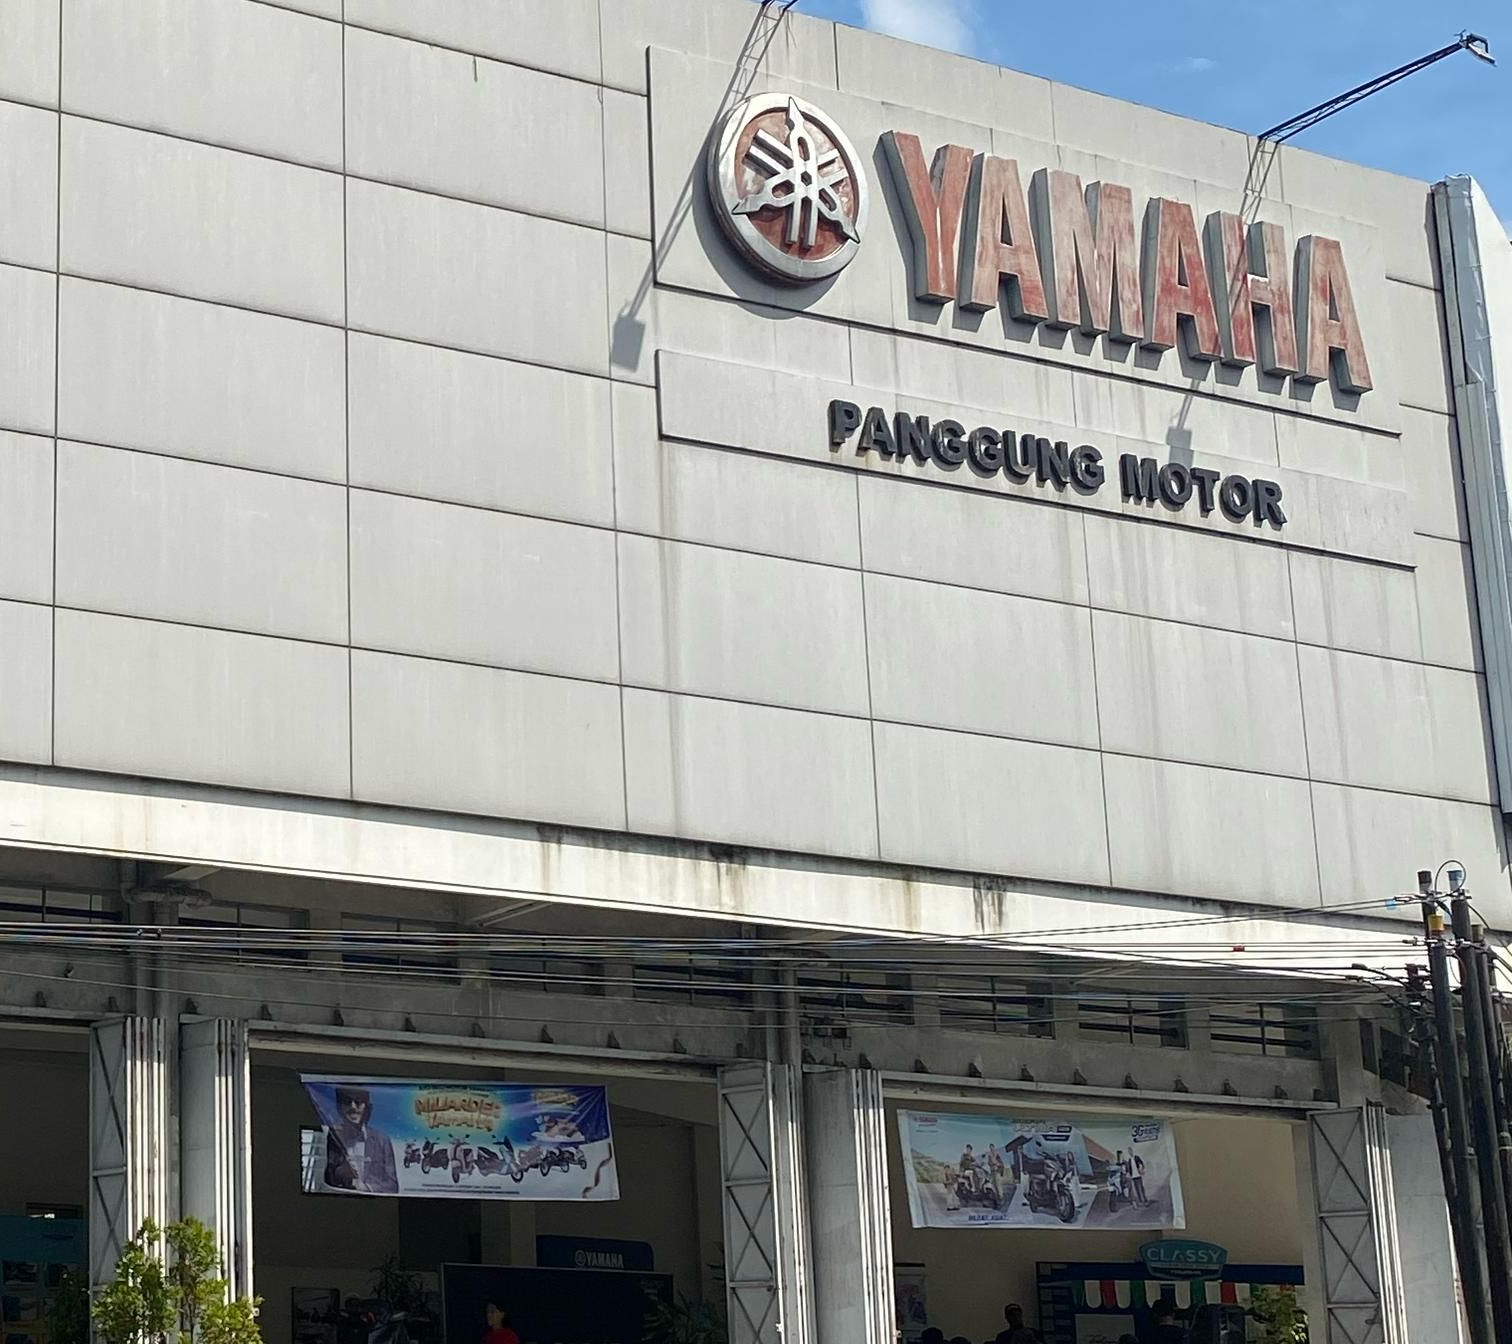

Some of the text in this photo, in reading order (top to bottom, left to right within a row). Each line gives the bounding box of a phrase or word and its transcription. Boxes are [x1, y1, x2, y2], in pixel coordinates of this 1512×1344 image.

[873, 131, 1372, 394] YAMAHA
[829, 399, 1287, 530] PANGGUNG MOTOR
[585, 1251, 625, 1269] YAMAHA
[1147, 1247, 1223, 1263] CLASSY
